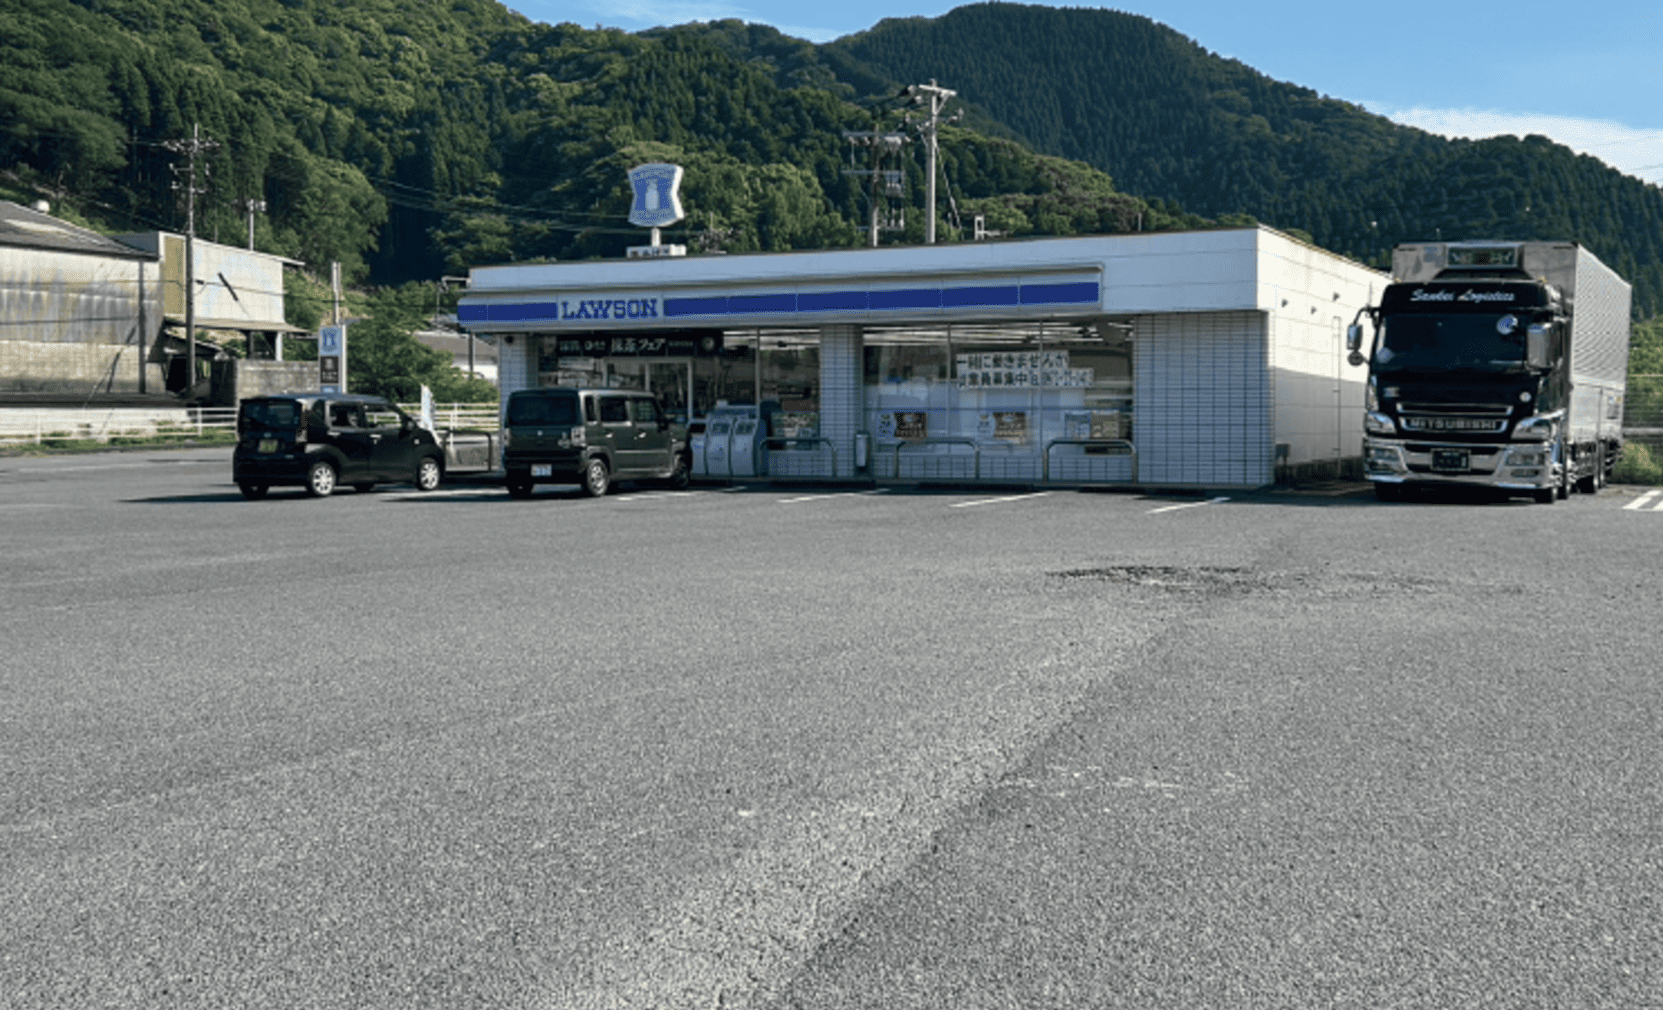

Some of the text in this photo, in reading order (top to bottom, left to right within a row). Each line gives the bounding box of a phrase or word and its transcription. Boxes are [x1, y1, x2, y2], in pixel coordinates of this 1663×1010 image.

[1457, 288, 1515, 303] Logistics
[561, 298, 658, 320] LAWSON
[1410, 417, 1497, 430] MITSUBISHI
